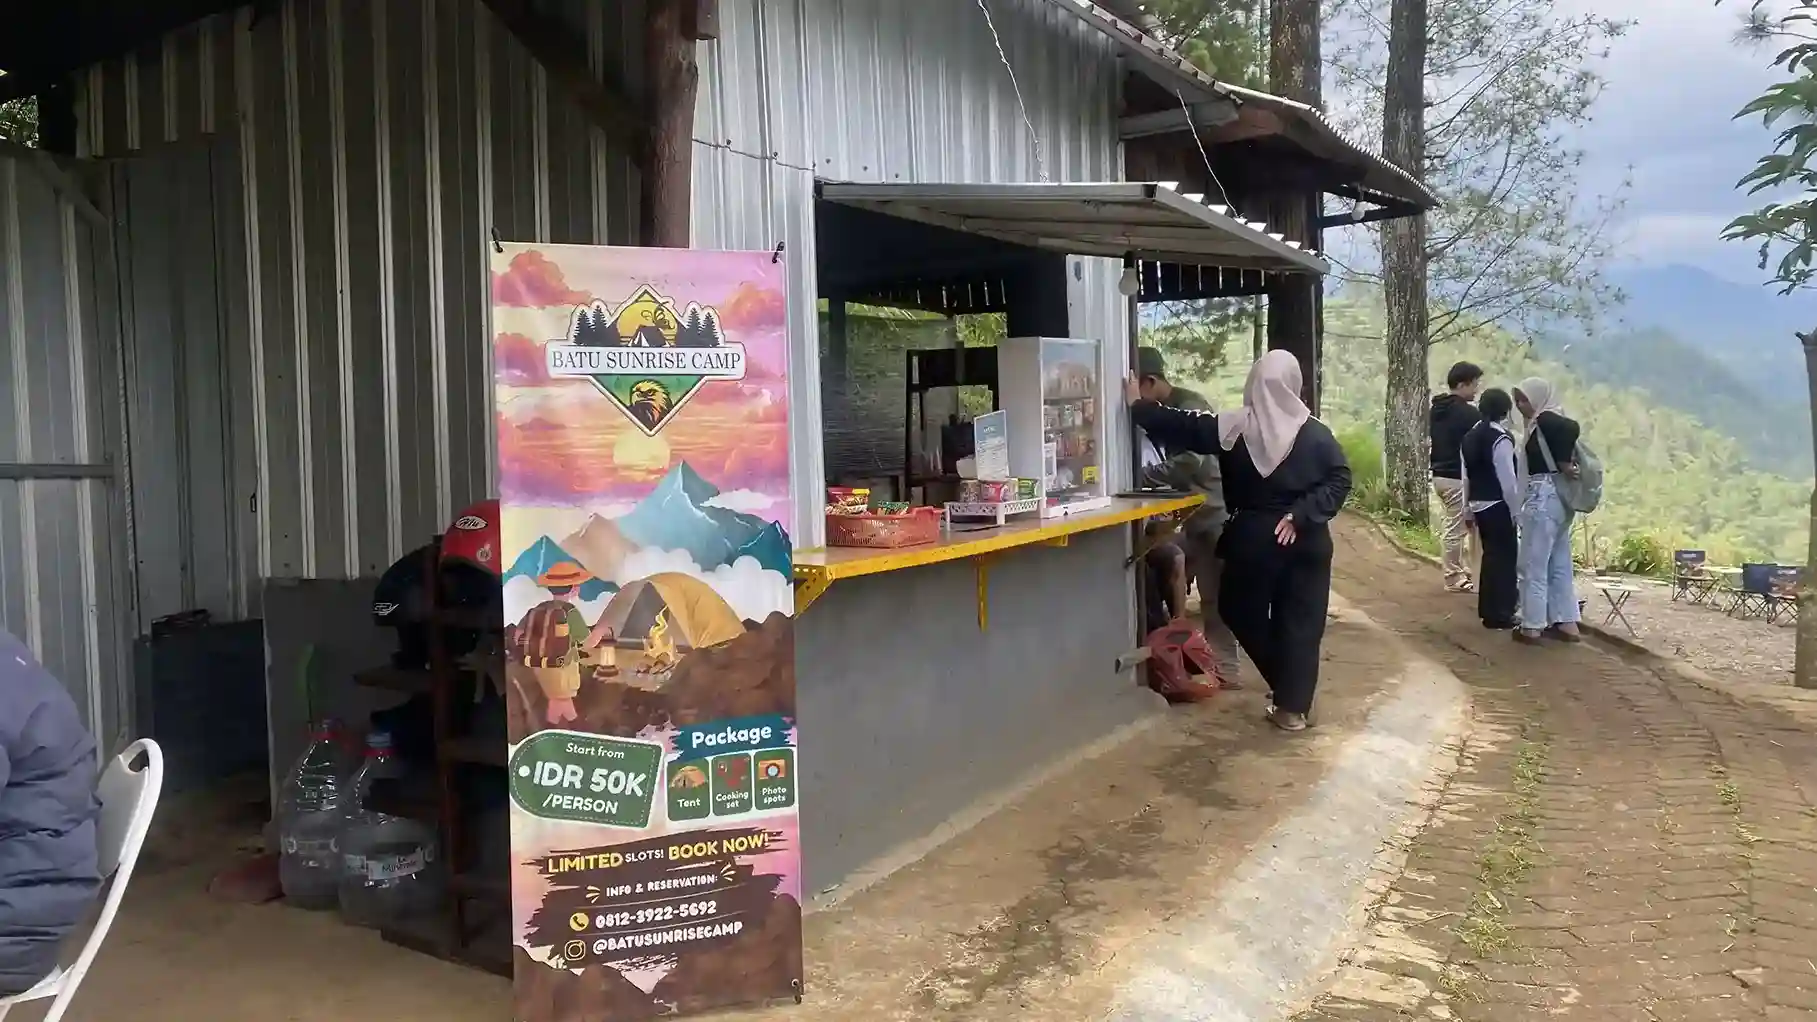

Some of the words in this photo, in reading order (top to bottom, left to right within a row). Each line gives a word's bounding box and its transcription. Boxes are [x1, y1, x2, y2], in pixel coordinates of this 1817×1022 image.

[552, 351, 600, 368] BATU
[606, 351, 686, 369] SUNRISE
[691, 352, 741, 369] CAMP
[691, 726, 772, 748] Package
[566, 742, 595, 756] Start
[597, 745, 625, 759] from
[533, 760, 584, 789] IDR
[589, 767, 647, 797] 50K
[715, 790, 749, 802] Cooking
[762, 786, 787, 796] Photo
[763, 795, 786, 805] spots
[542, 793, 618, 814] /PERSON
[677, 798, 701, 808] Tent
[548, 852, 623, 873] LIMITED
[625, 849, 664, 863] SLOTS!
[668, 840, 718, 861] BOOK
[722, 833, 769, 853] NOW!
[606, 885, 632, 897] INFO
[635, 883, 644, 894] &
[647, 873, 718, 891] RESERVATION:
[595, 900, 717, 929] 0812-3922-5692
[592, 921, 744, 955] @BATUSUNRISECAMP
